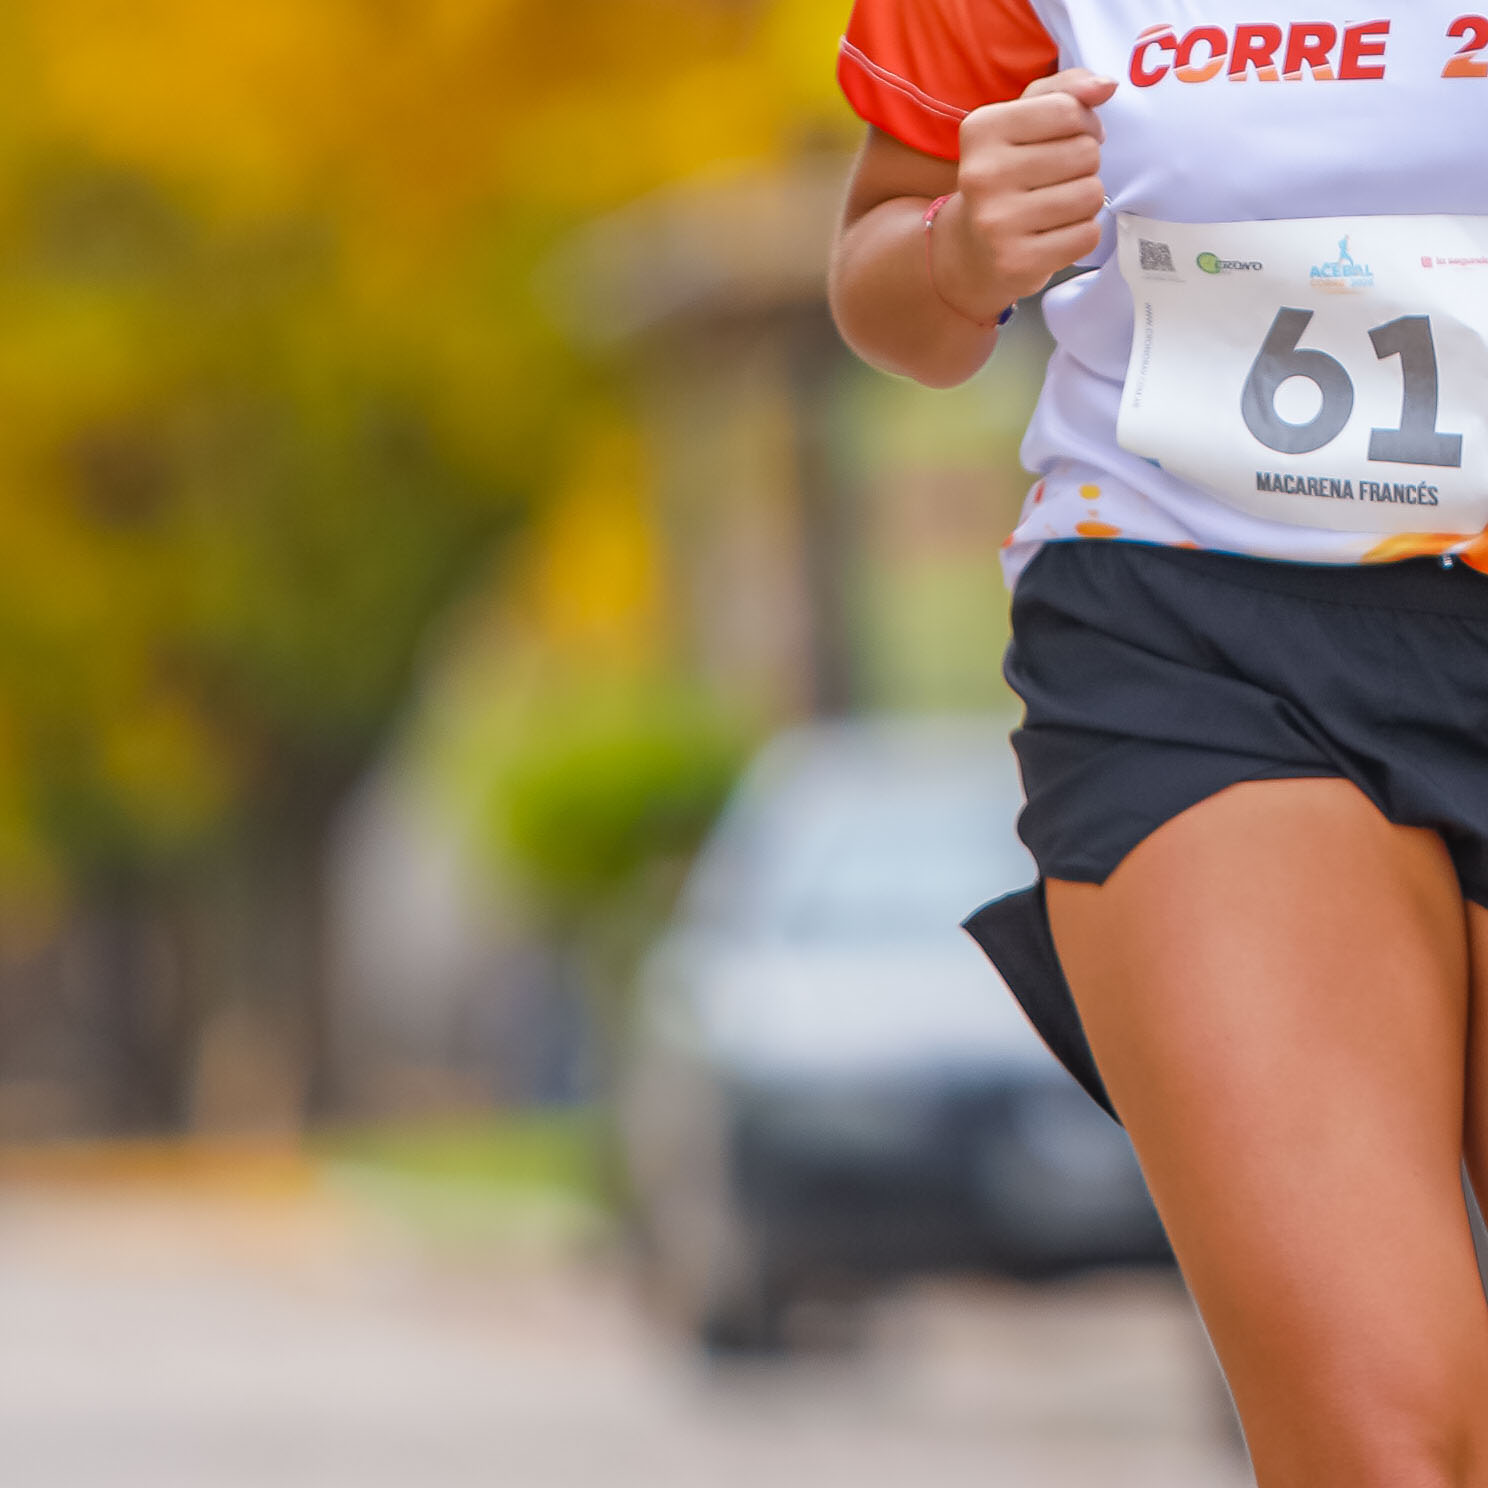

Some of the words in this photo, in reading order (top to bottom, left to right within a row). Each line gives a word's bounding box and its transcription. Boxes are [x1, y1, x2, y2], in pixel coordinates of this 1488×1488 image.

[1129, 20, 1391, 88] CORRE
[1241, 306, 1463, 468] 61
[1256, 471, 1354, 500] MACARENA
[1359, 481, 1439, 506] FRANCÉS
